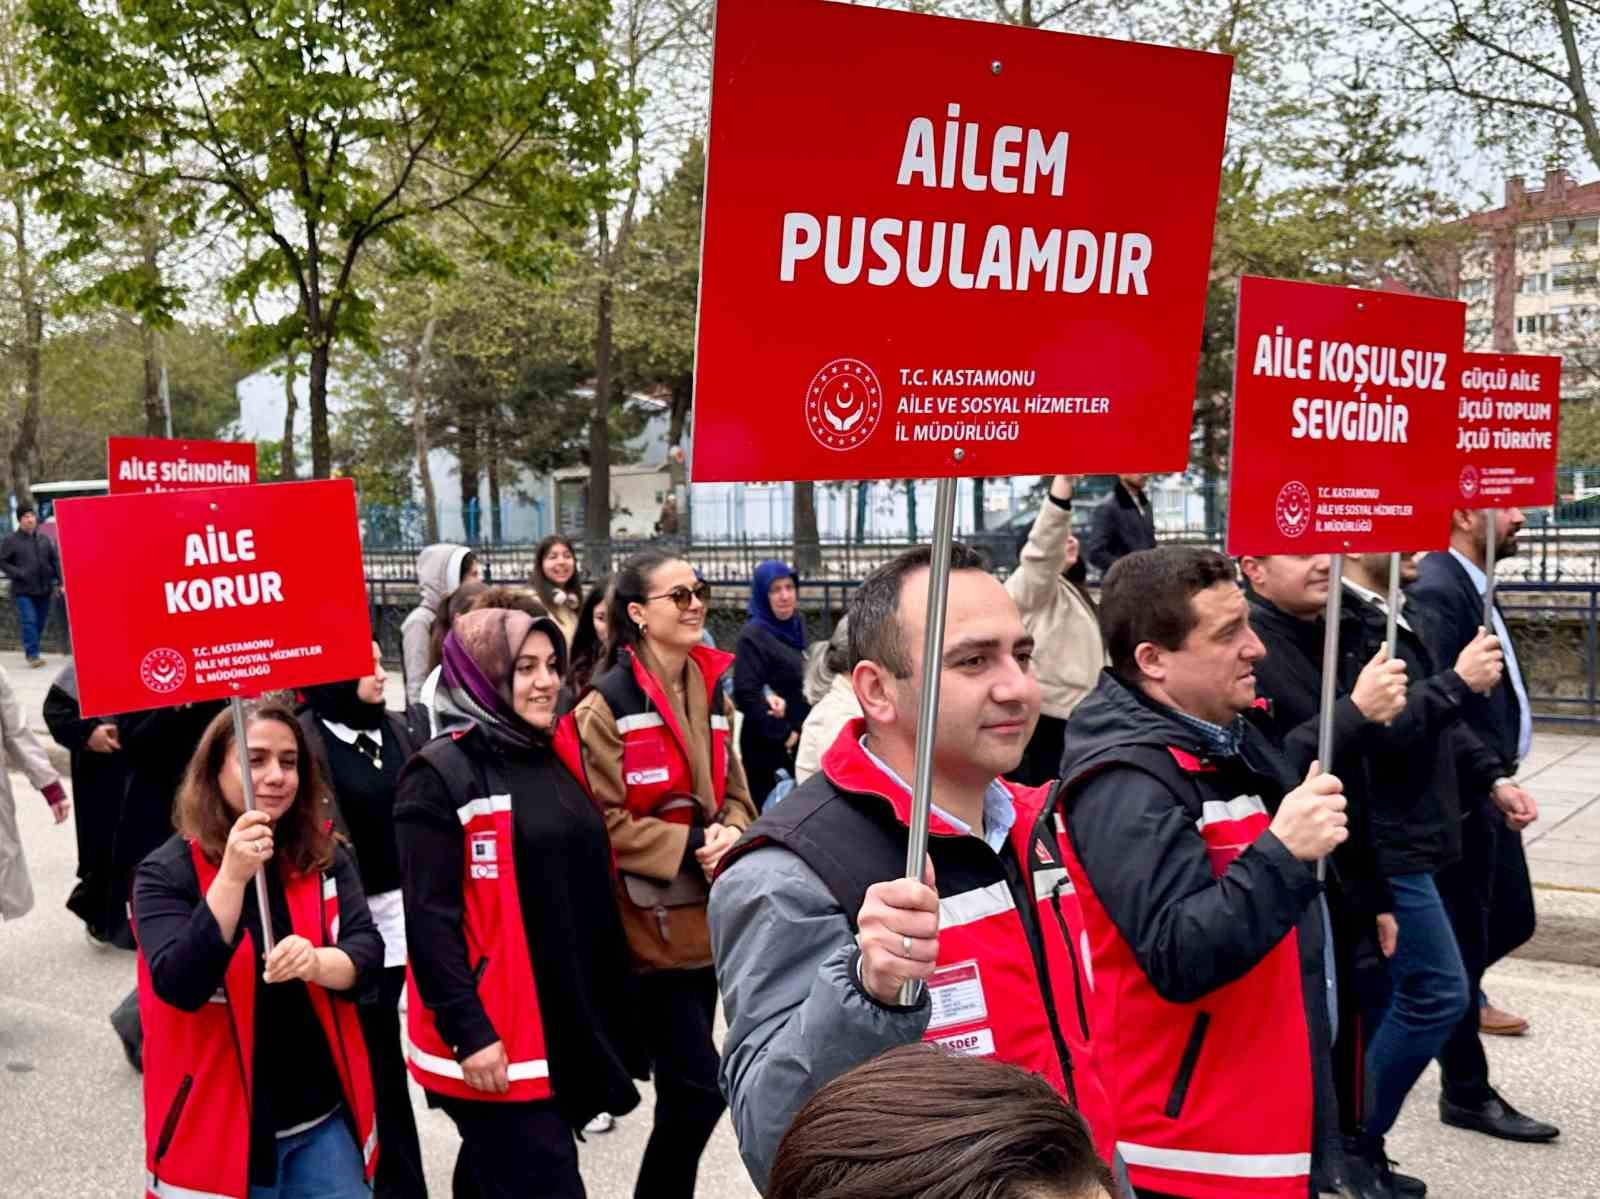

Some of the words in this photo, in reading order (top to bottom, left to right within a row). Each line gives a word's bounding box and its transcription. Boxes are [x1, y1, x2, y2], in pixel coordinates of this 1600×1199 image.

[896, 102, 1069, 196] AİLEM
[780, 212, 1153, 296] PUSULAMDIR
[1253, 325, 1313, 380] AİLE
[1318, 340, 1448, 393] KOŞULSUZ
[900, 369, 928, 385] T.C.
[932, 369, 1036, 386] KASTAMONU
[1461, 367, 1507, 393] GÜÇLÜ
[1509, 369, 1541, 391] AİLE
[897, 393, 934, 414] AİLE
[936, 397, 957, 414] VE
[960, 397, 1021, 414] SOSYAL
[1024, 394, 1110, 414] HİZMETLER
[1496, 402, 1551, 420] TOPLUM
[1291, 392, 1409, 443] SEVGİDİR
[895, 421, 910, 441] İL
[913, 421, 1020, 441] MÜDÜRLÜĞÜ
[1492, 427, 1552, 449] TÜRKİYE
[118, 456, 158, 481] AİLE
[160, 458, 249, 484] SIĞINDIĞIN
[184, 524, 256, 567] AİLE
[164, 571, 284, 614] KORUR
[192, 647, 211, 657] T.C.
[212, 639, 274, 655] KASTAMONU
[195, 657, 217, 670] AİLE
[217, 656, 230, 667] VE
[232, 652, 269, 666] SOSYAL
[270, 645, 323, 661] HİZMETLER
[196, 672, 205, 684] İL
[207, 664, 271, 682] MÜDÜRLÜĞÜ
